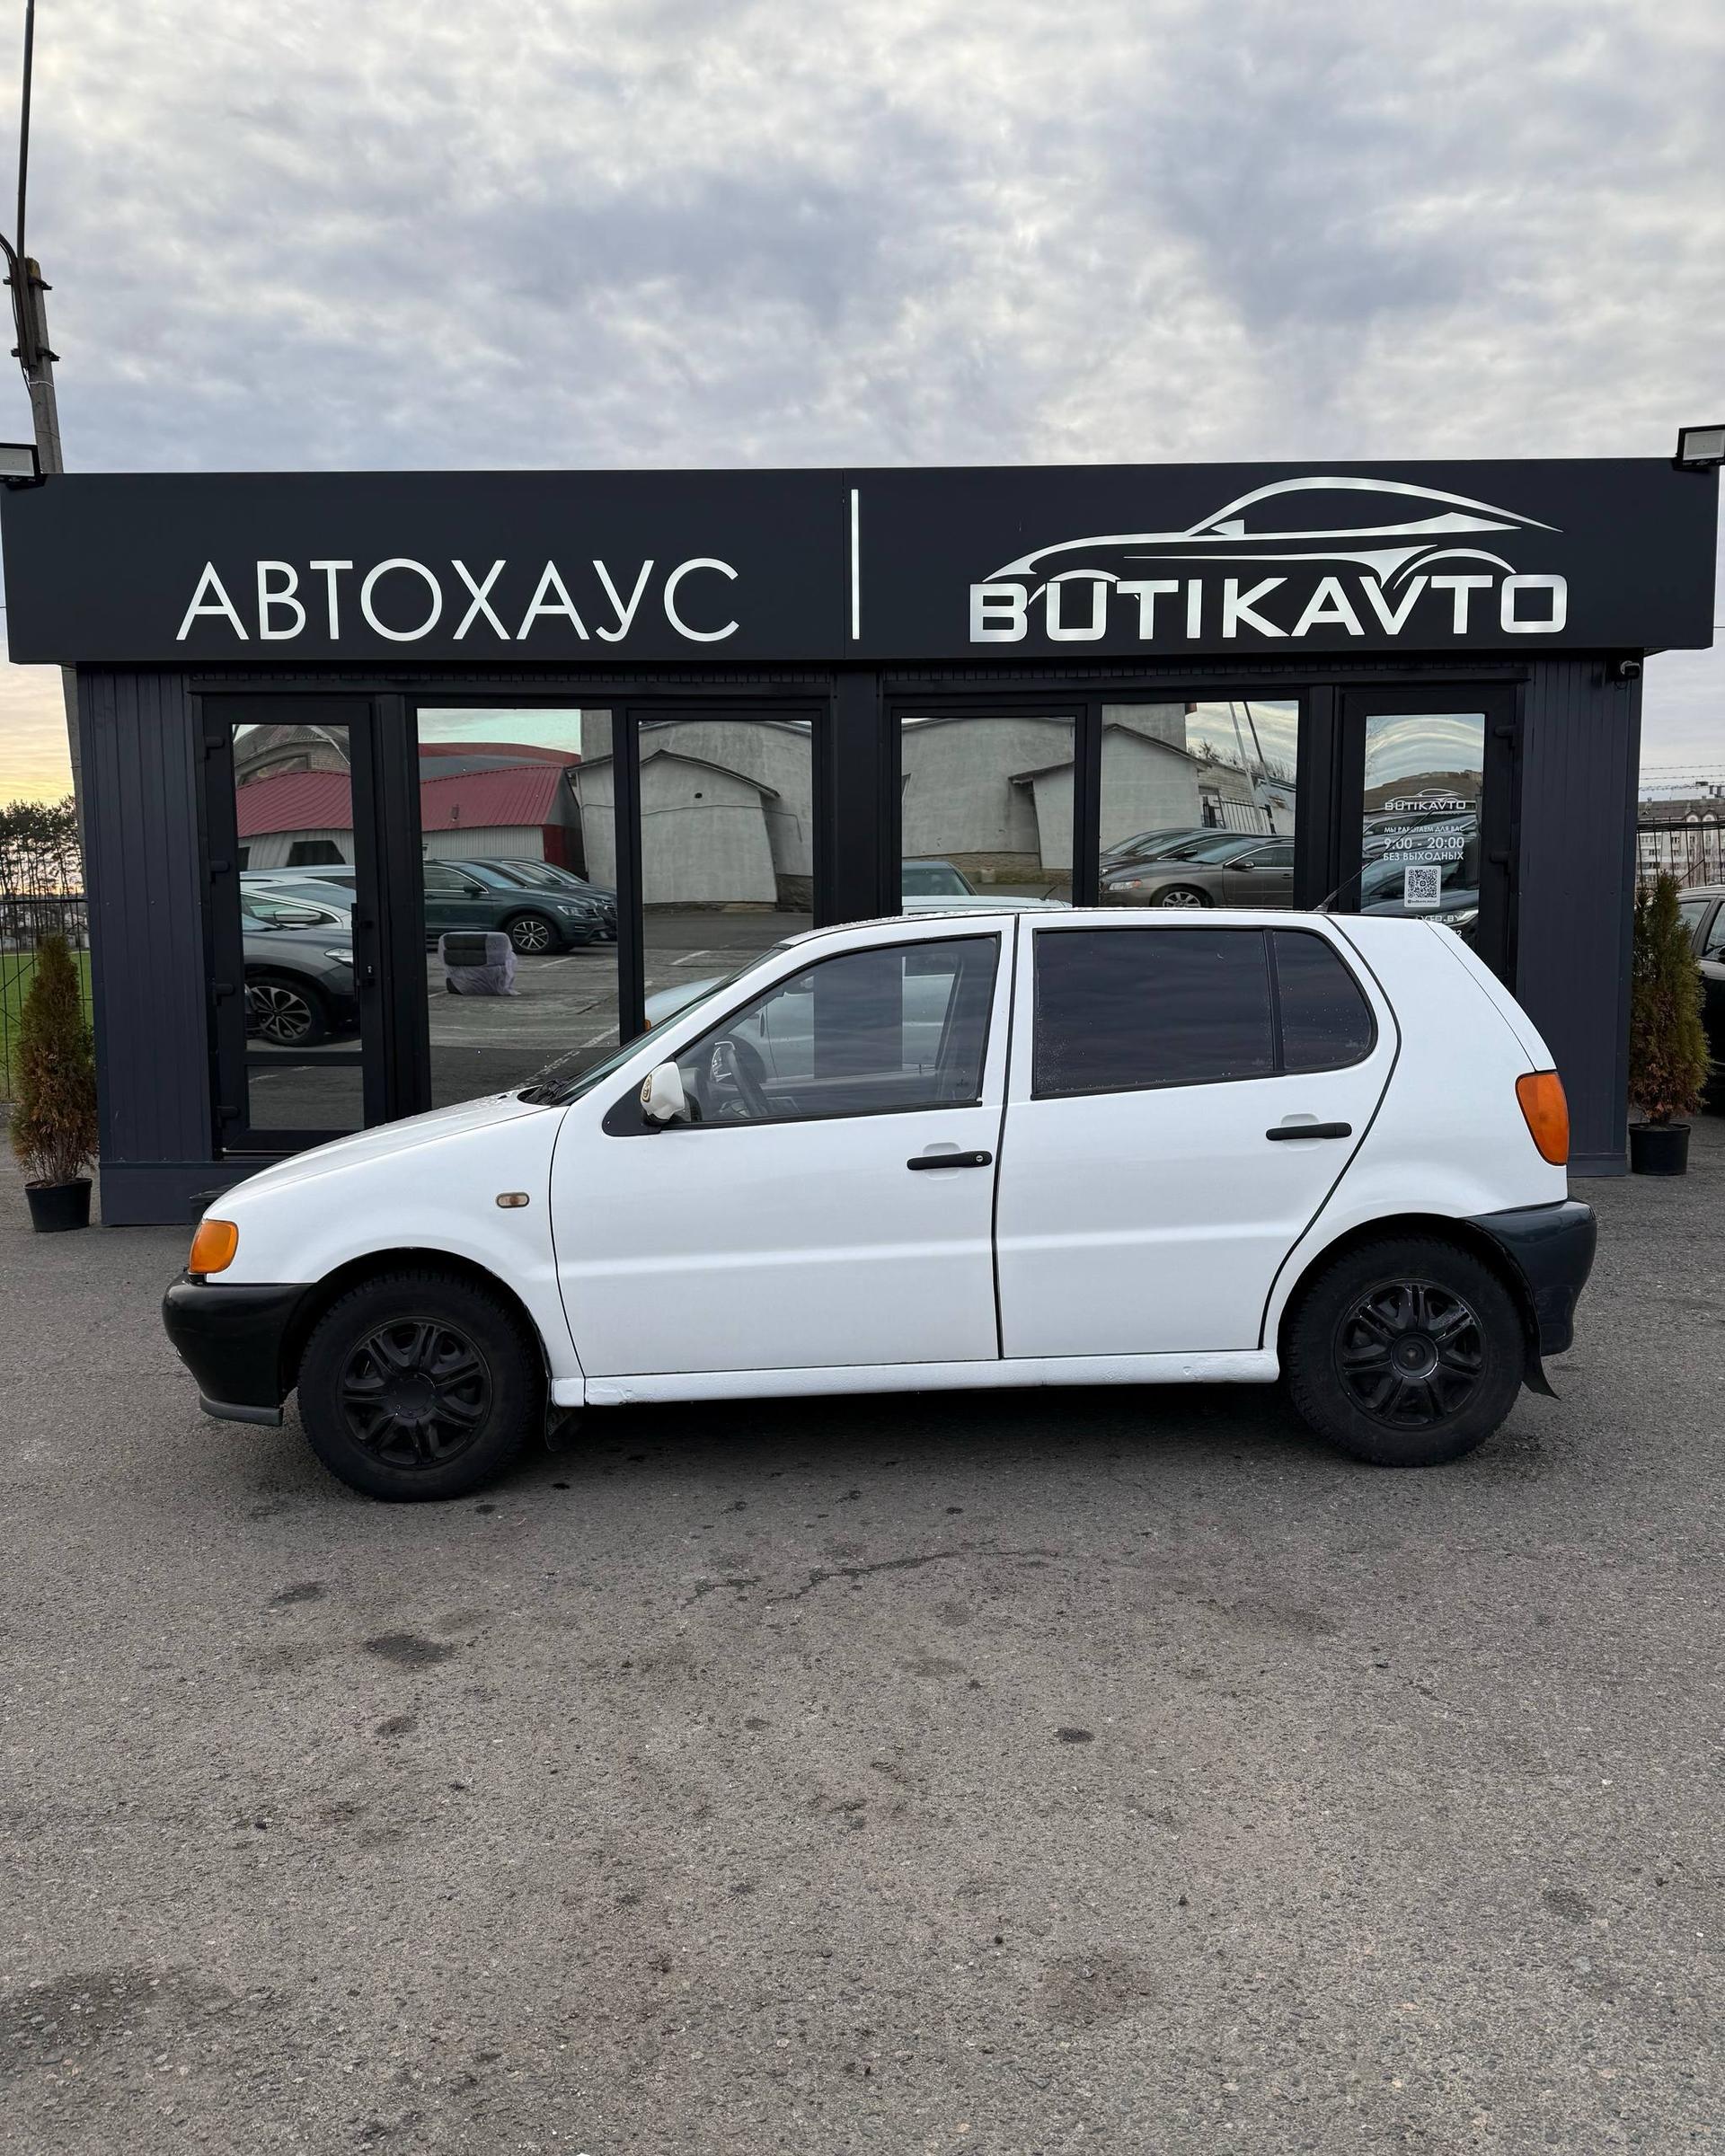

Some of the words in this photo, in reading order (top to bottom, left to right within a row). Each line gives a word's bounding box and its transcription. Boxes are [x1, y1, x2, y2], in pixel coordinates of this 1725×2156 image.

[175, 557, 739, 642] АВТОХАУС
[969, 573, 1567, 643] BUTIKAVTO
[1384, 801, 1466, 810] BUTIKAVTO
[1427, 836, 1464, 849] 20:00
[1384, 852, 1400, 861] БЕЗ
[1402, 851, 1464, 861] ВЫХОДНЫХ
